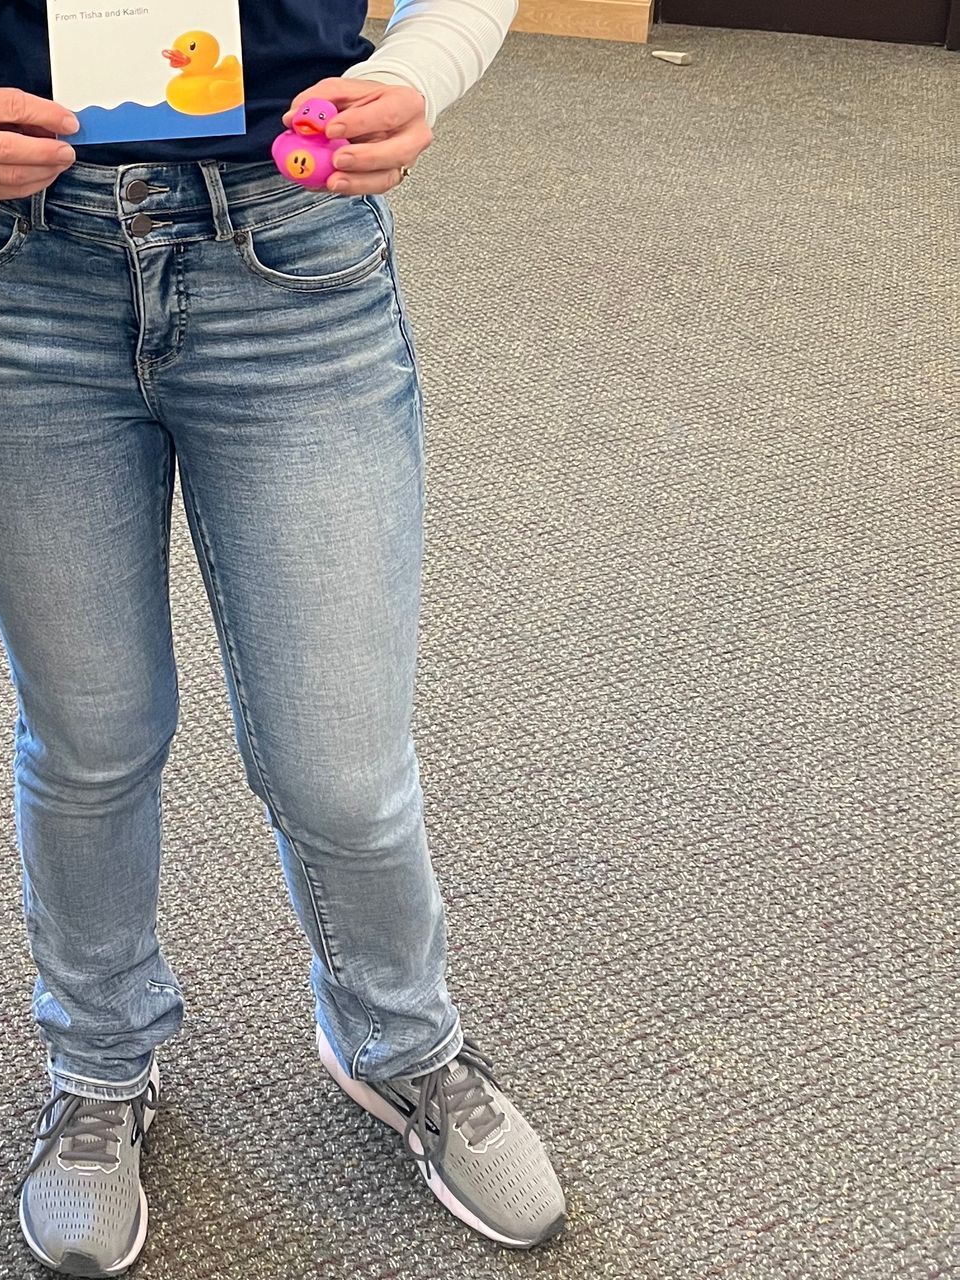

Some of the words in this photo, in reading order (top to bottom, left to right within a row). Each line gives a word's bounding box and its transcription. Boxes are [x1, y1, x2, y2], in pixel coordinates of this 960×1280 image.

[55, 13, 77, 21] From
[80, 10, 103, 20] Tisha
[105, 9, 121, 18] and
[122, 7, 149, 17] Kaitlin
